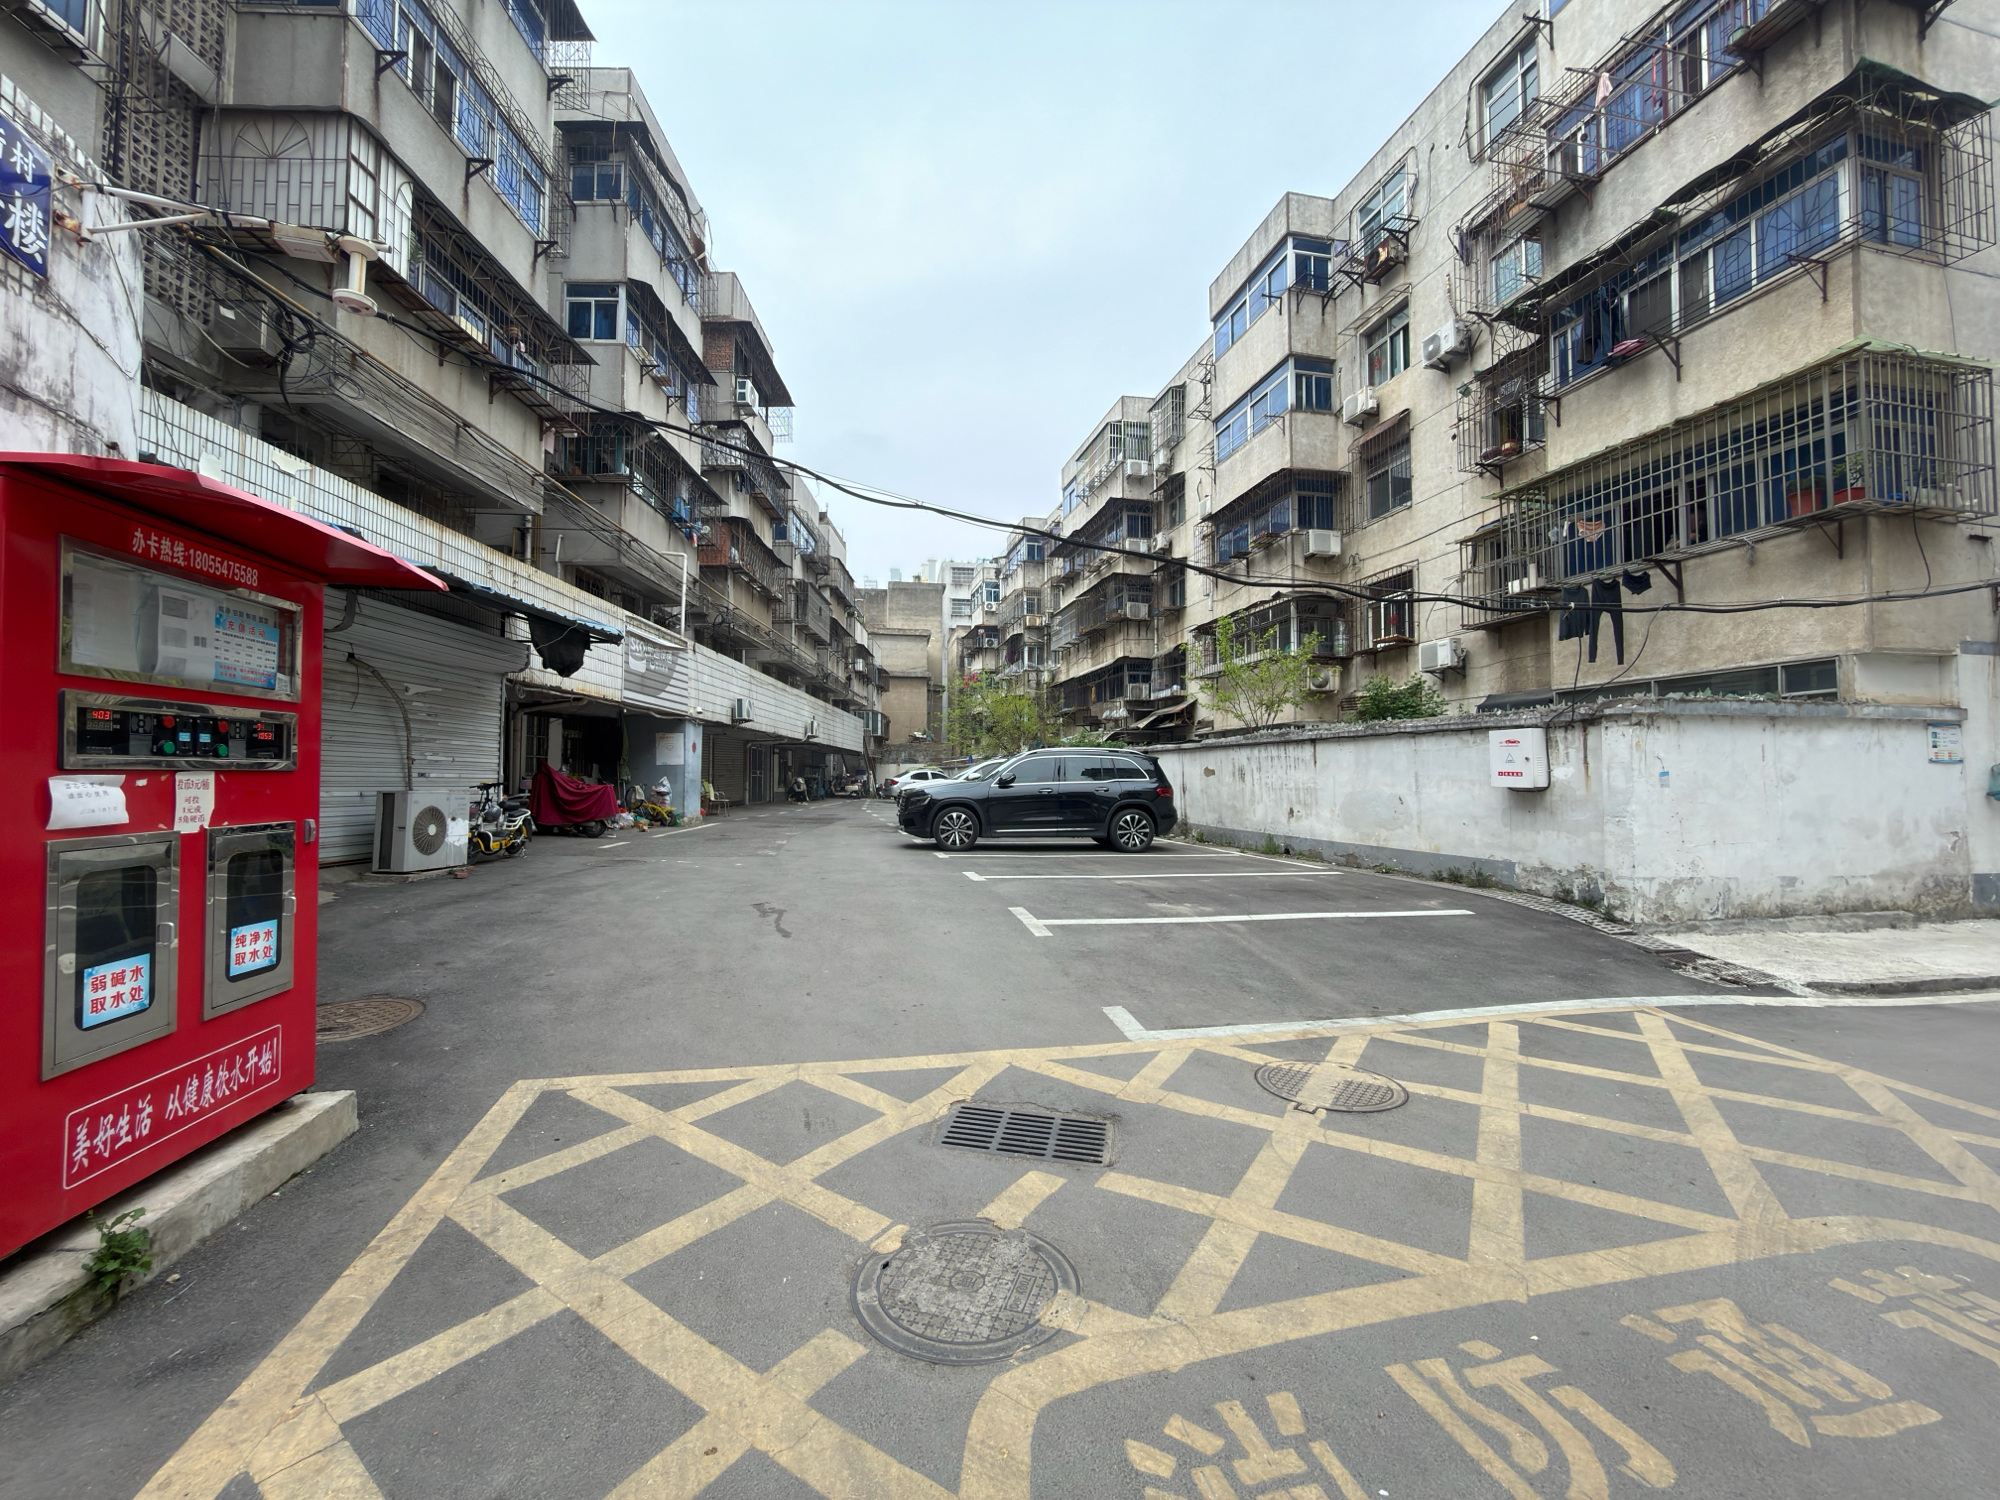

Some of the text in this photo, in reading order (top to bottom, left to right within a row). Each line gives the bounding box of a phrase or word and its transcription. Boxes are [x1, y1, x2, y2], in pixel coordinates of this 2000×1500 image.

[0, 190, 48, 264] 楼
[132, 527, 258, 587] 办卡热线:18055475588
[227, 619, 266, 638] 充值活动
[234, 928, 274, 949] 纯净水
[234, 944, 274, 967] 取水处
[90, 965, 145, 994] 弱碱水
[90, 985, 144, 1015] 取水处
[71, 1093, 154, 1174] 美好生活
